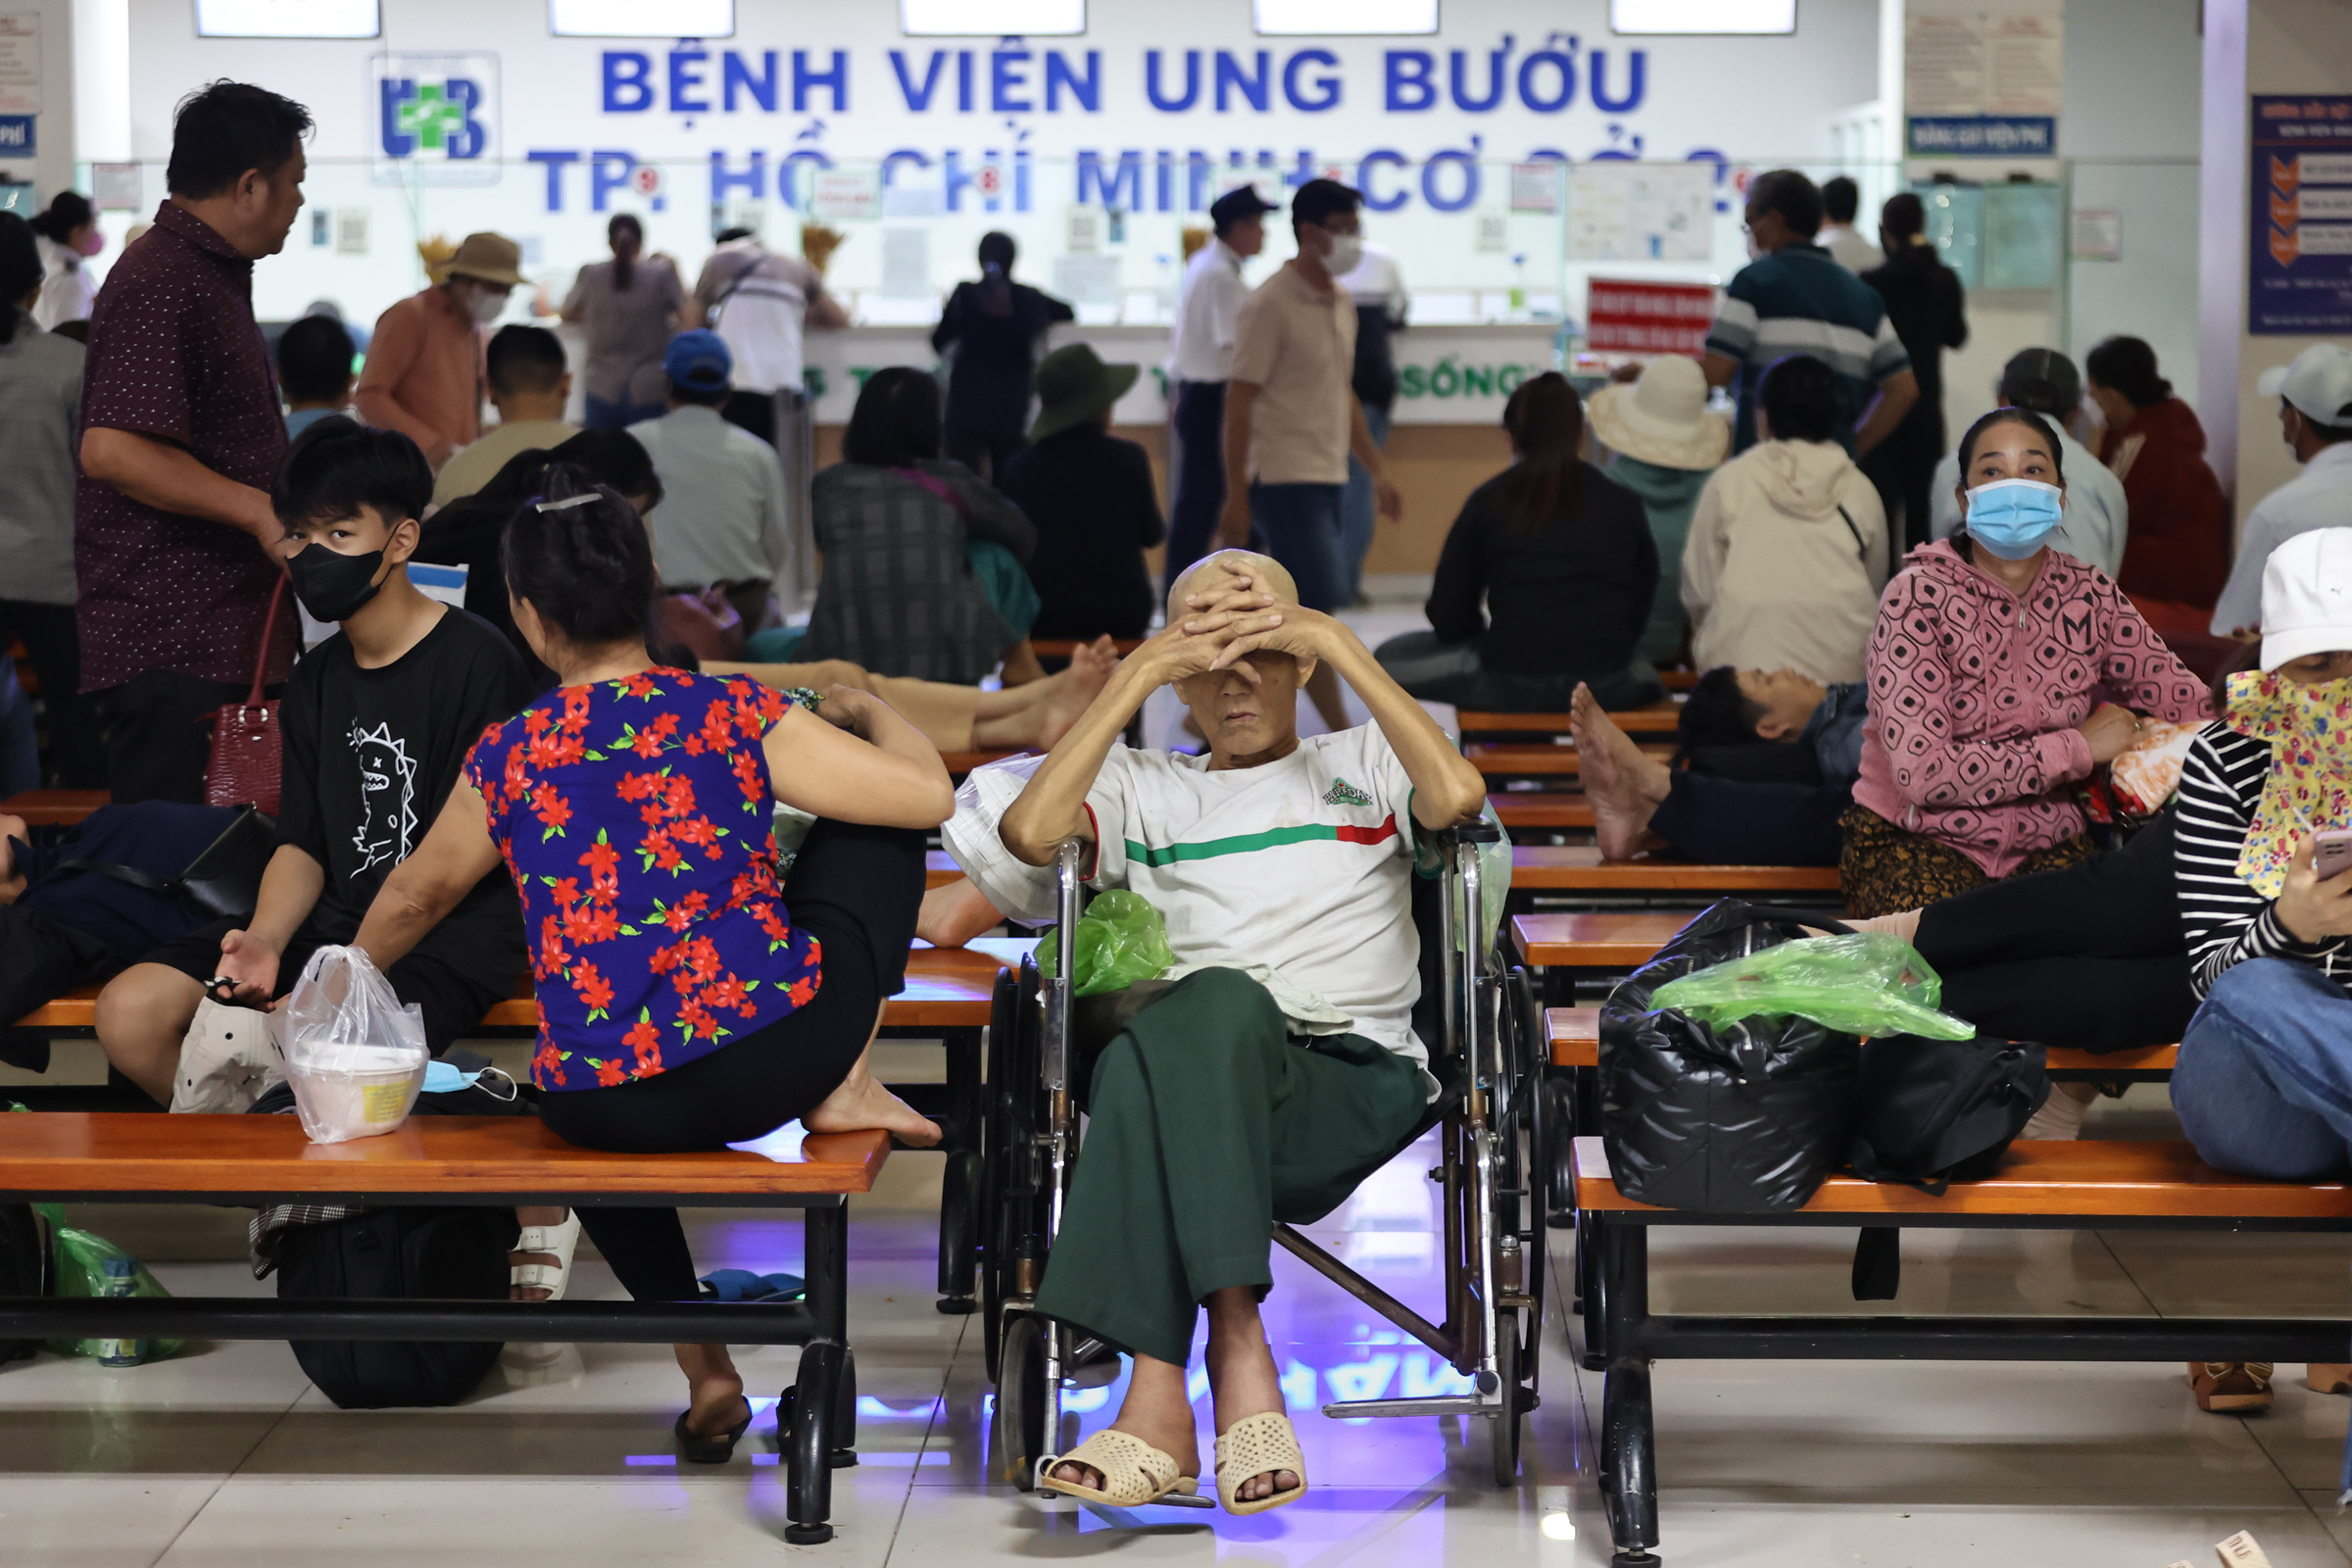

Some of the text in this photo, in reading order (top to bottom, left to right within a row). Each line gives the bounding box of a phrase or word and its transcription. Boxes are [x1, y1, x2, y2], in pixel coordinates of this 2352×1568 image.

[602, 35, 849, 131] BỆNH
[888, 35, 1102, 133] VIỆN
[1147, 48, 1343, 115] UNG
[1357, 134, 1484, 214] CƠ
